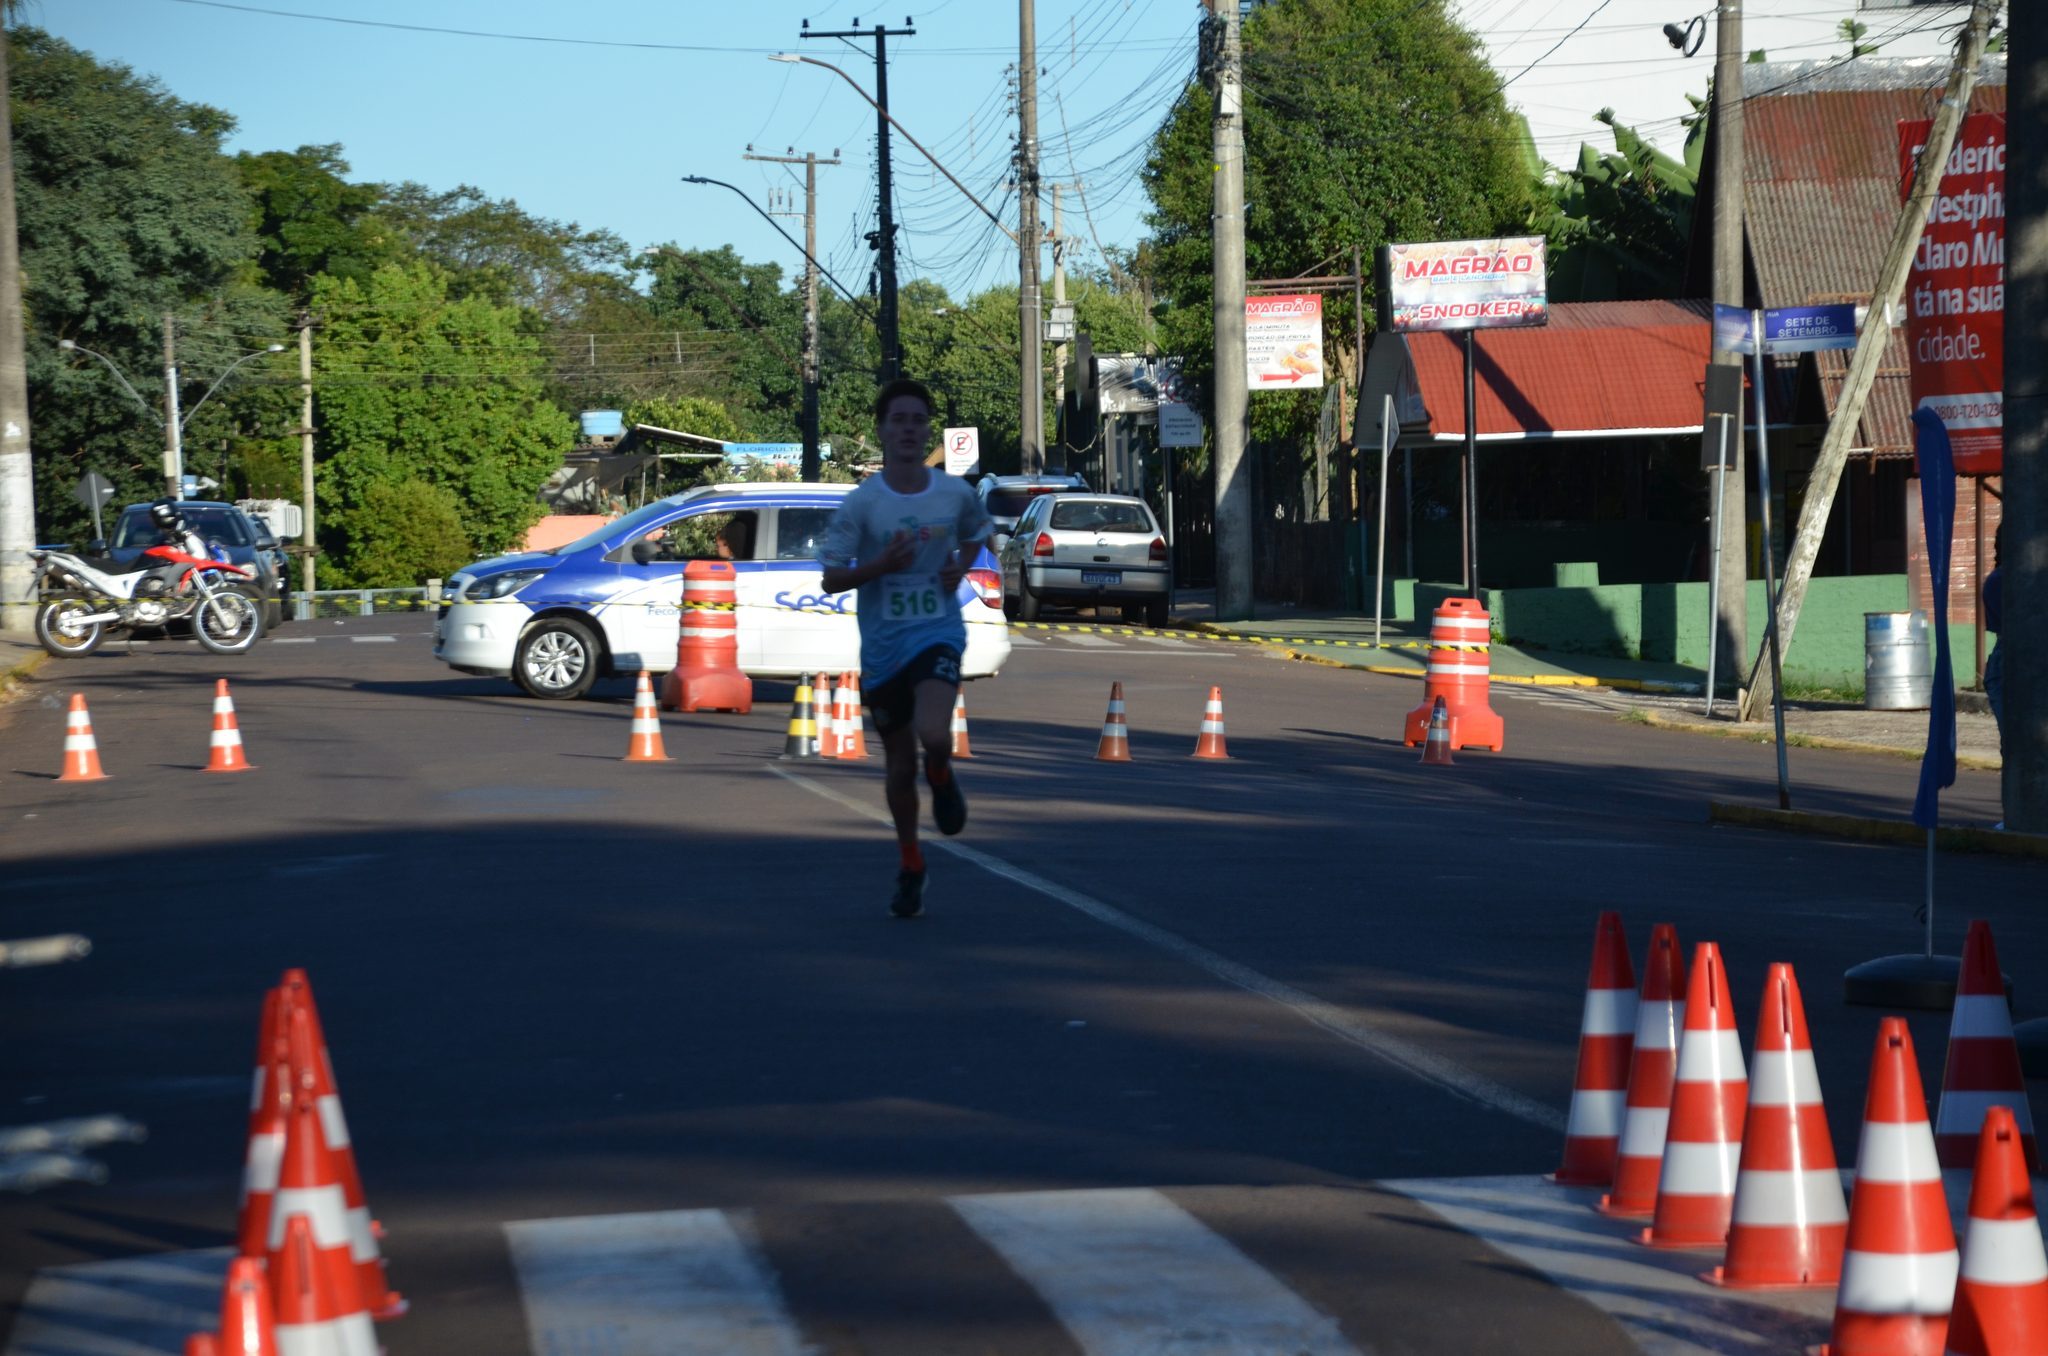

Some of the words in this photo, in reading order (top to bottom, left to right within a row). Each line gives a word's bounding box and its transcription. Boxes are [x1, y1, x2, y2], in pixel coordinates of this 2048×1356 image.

[1405, 248, 1533, 279] MAGRÃO
[1246, 298, 1317, 314] MAGRÃO
[1419, 301, 1522, 319] SNOOKER
[1914, 280, 1934, 317] tá
[1937, 286, 1964, 316] na
[1778, 325, 1838, 338] SETEMBRO
[1785, 317, 1813, 328] SETE
[1815, 316, 1830, 326] DE
[1917, 323, 1986, 362] cidade.
[890, 589, 938, 617] 516
